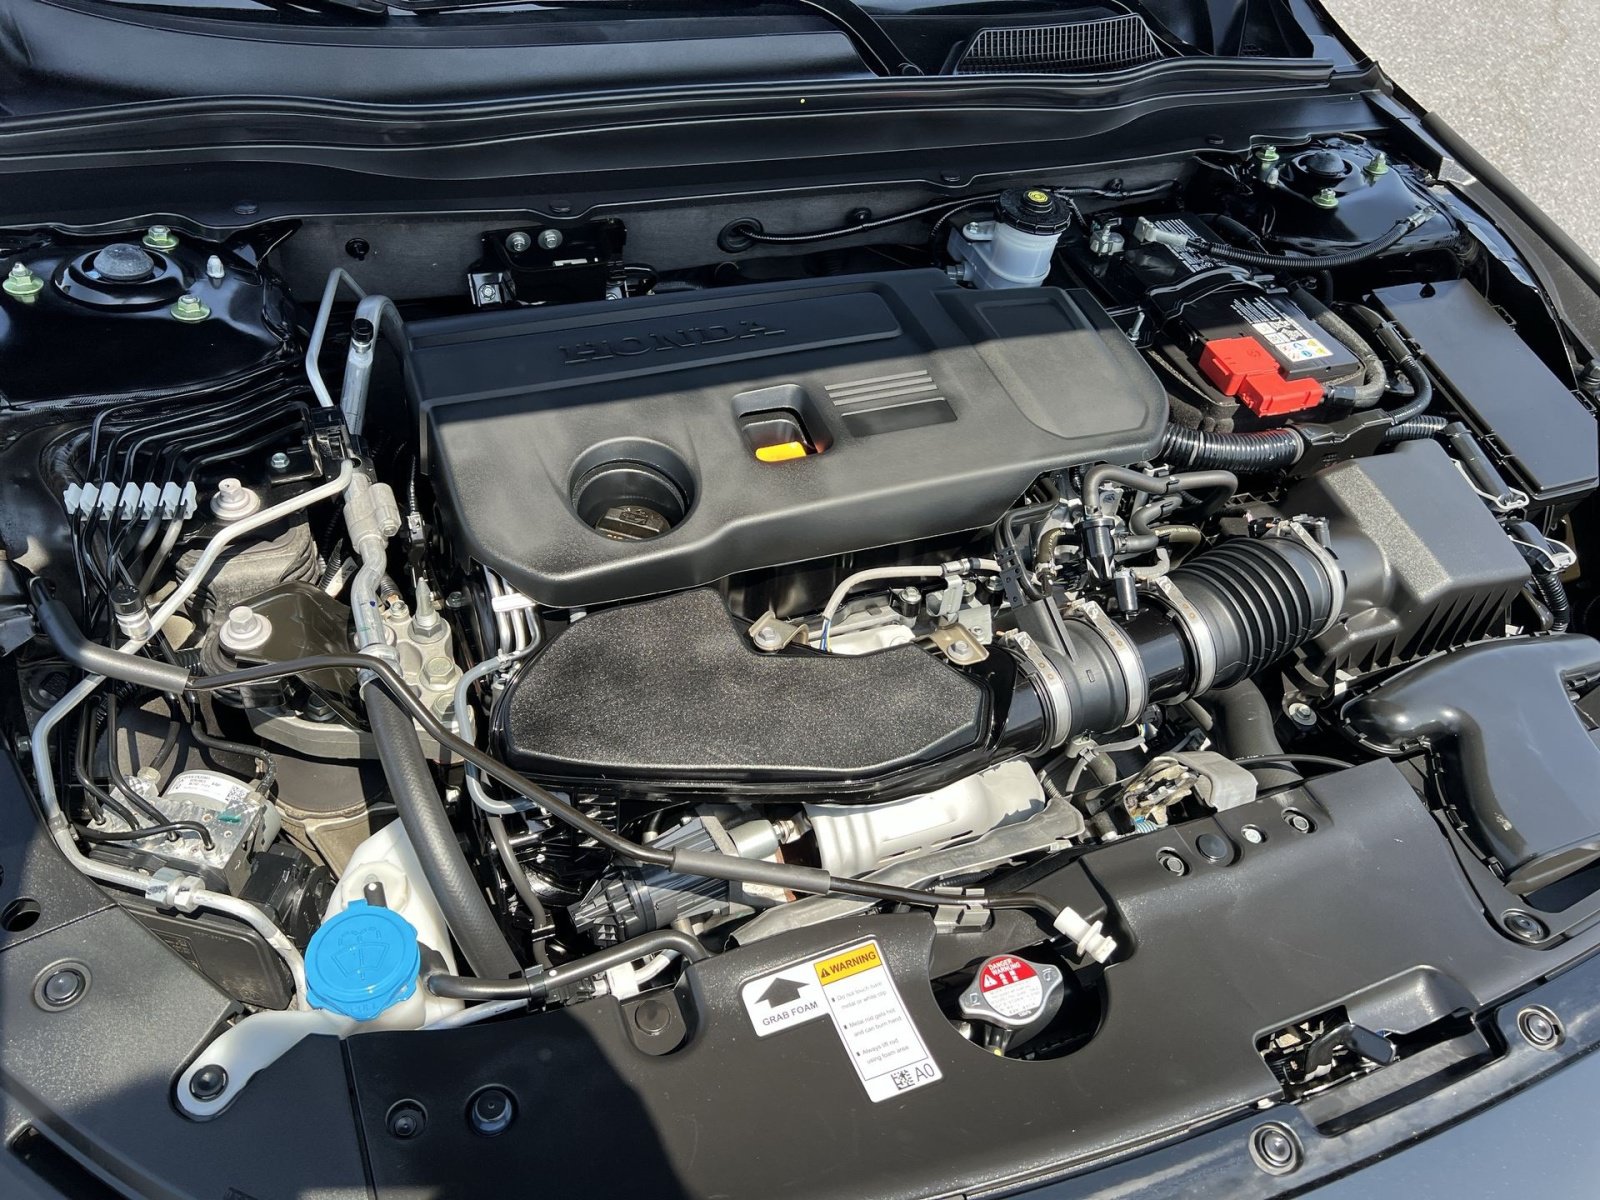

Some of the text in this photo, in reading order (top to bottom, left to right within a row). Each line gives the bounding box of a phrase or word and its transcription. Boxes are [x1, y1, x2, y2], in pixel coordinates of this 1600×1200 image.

[557, 320, 786, 364] HONDA
[829, 951, 876, 974] WARNING
[988, 958, 1013, 970] DANGER
[855, 985, 869, 994] touch
[762, 1001, 818, 1026] GRAB FOAM
[862, 1045, 881, 1055] Always
[867, 1055, 882, 1064] using
[882, 1049, 896, 1058] foam
